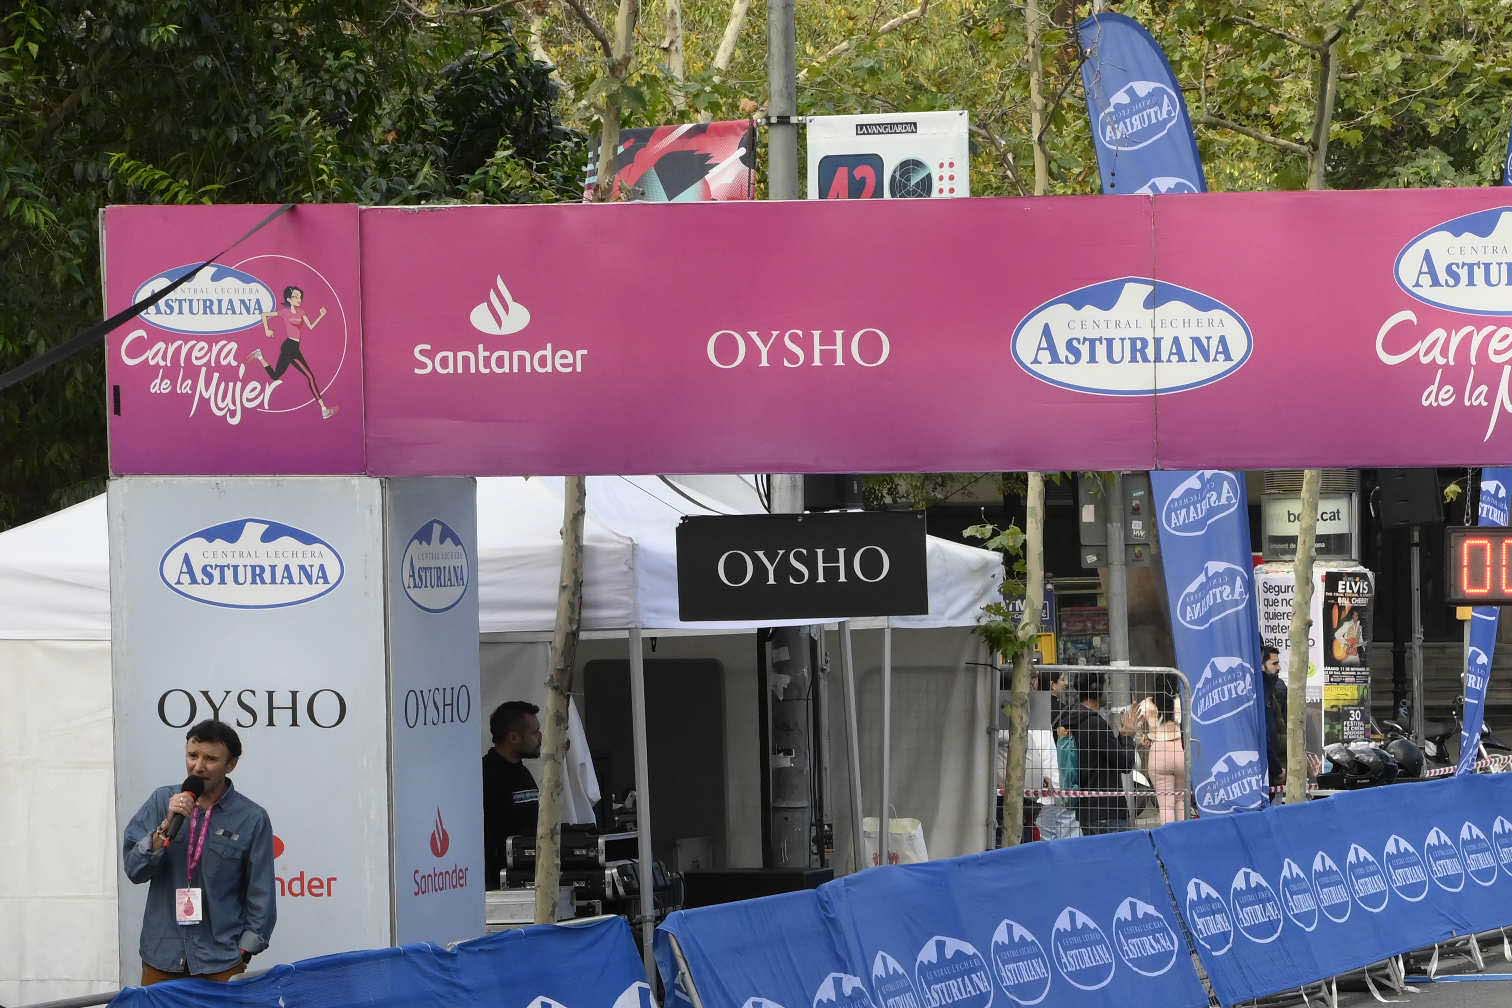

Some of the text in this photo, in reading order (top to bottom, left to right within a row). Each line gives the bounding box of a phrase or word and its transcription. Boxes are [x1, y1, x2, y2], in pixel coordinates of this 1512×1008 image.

[176, 287, 209, 295] ENTRAL
[1068, 317, 1226, 331] CENTRAL LECHERA
[121, 329, 238, 366] Carrera
[413, 343, 588, 375] Santander
[707, 328, 890, 368] OYSHO
[1030, 321, 1234, 366] ASTURIANA
[150, 363, 283, 426] de la Mujer
[1421, 368, 1456, 407] de
[1464, 368, 1488, 407] la
[174, 552, 331, 586] ASTURIANA
[202, 549, 325, 559] CENTRAL LECHERA
[717, 545, 890, 587] OYSHO
[408, 560, 466, 589] ASTURIANA
[1338, 580, 1368, 593] ELVIS
[1263, 598, 1279, 609] que
[1264, 636, 1283, 647] este
[157, 688, 347, 729] OYSHO
[405, 684, 471, 729] OYSHO
[413, 863, 469, 898] Santander
